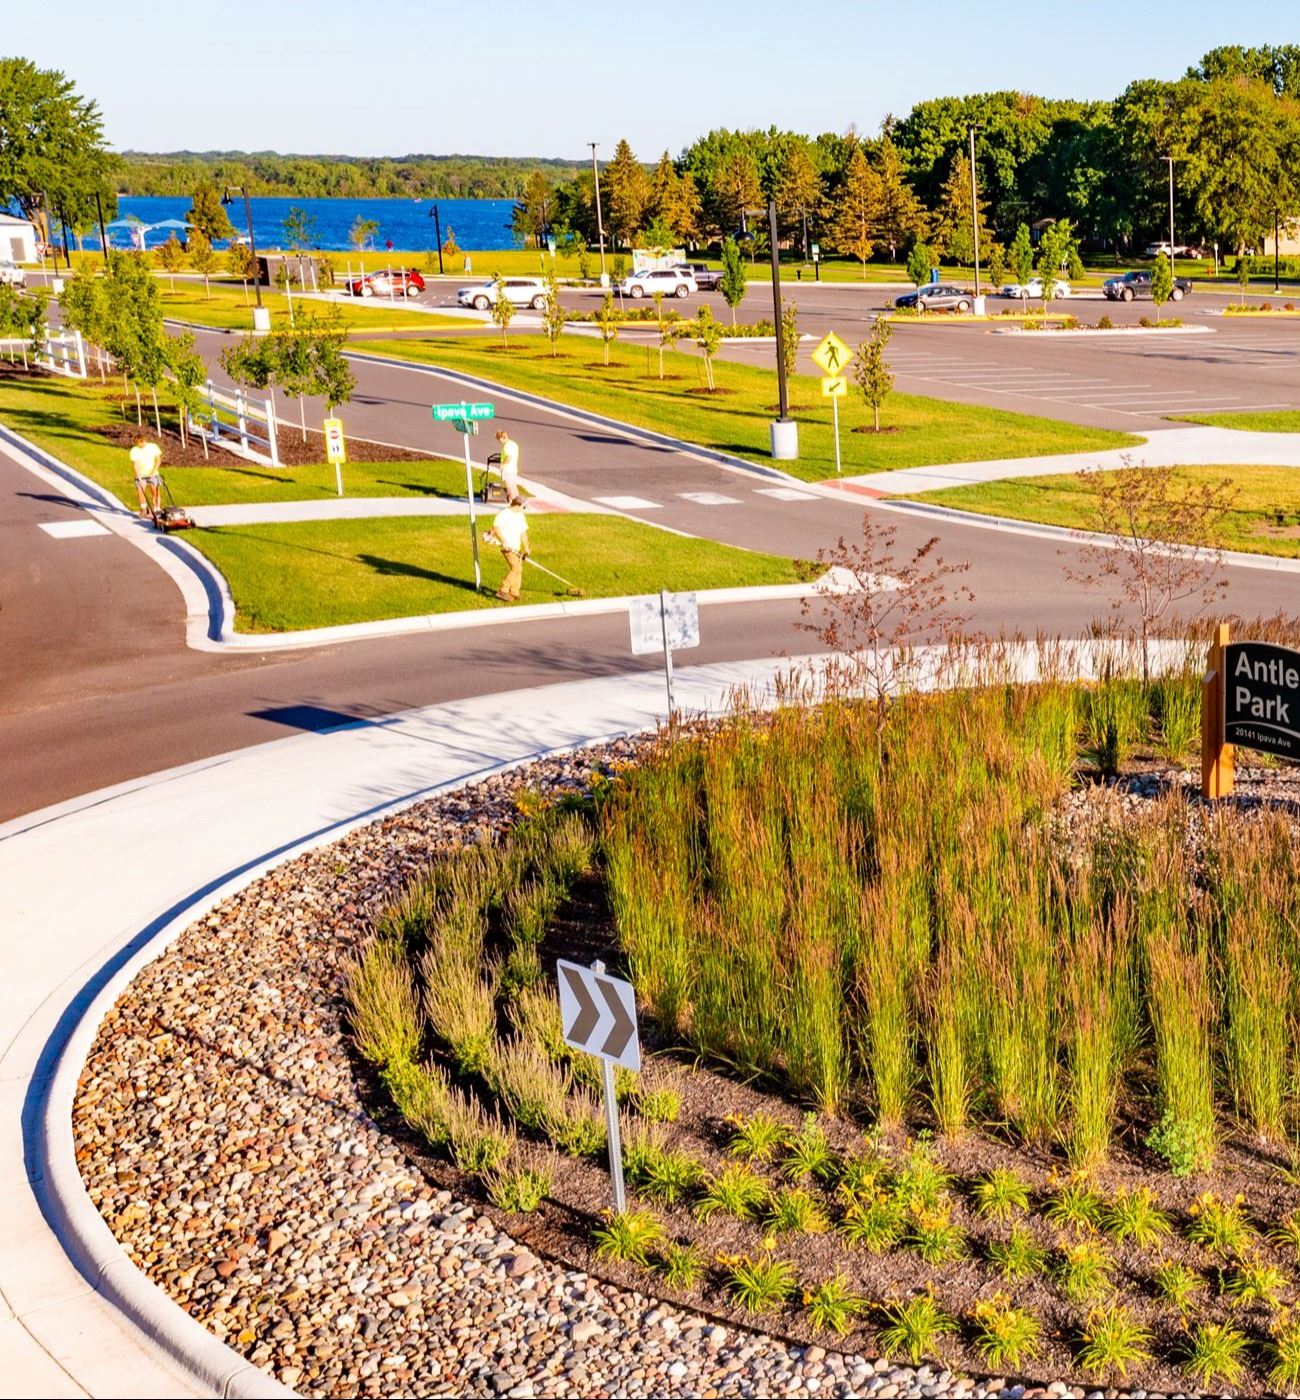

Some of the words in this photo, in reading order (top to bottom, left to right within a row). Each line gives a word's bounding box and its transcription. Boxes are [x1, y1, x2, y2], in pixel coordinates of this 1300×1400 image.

[437, 405, 466, 420] Ipava
[470, 405, 490, 417] Ave
[1236, 685, 1290, 724] Park
[1235, 727, 1256, 739] 20141
[1257, 732, 1276, 744] Ipava
[1277, 737, 1292, 749] Ave
